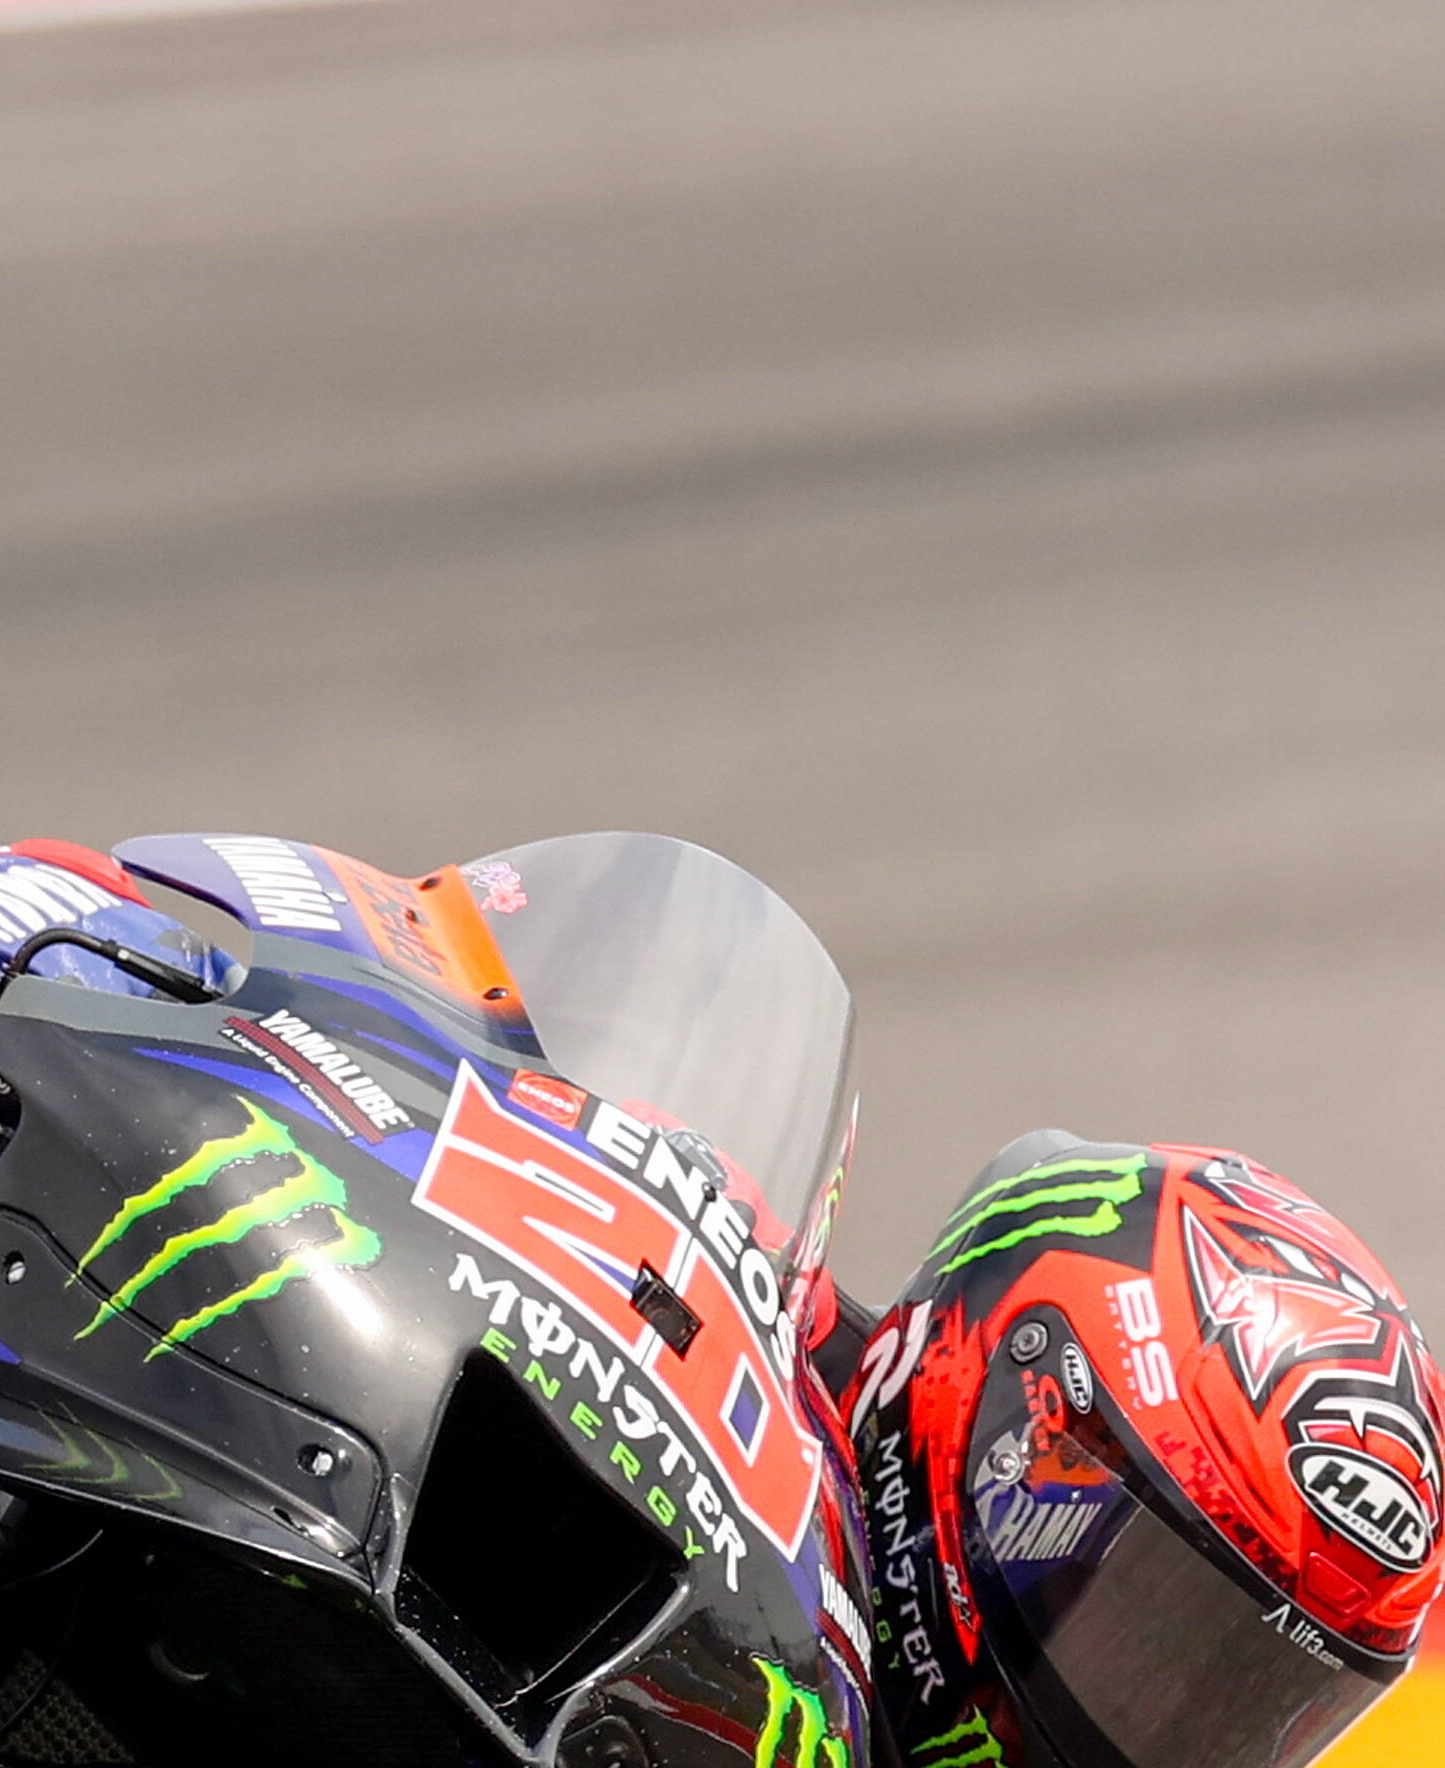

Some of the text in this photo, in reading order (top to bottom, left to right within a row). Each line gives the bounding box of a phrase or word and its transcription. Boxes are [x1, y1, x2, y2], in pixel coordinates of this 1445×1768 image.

[203, 838, 342, 932] YAMAHA
[233, 1035, 269, 1058] Liquid
[265, 1056, 301, 1084] Engine
[298, 1083, 356, 1138] Component
[259, 1009, 410, 1130] YAMALUBE
[586, 1100, 798, 1383] ENEOS
[1064, 1352, 1090, 1407] HJC
[1104, 1285, 1143, 1411] BATTERY
[1115, 1278, 1179, 1406] BS
[480, 1327, 706, 1560] ENERGY
[1308, 1460, 1425, 1556] HJC
[1340, 1510, 1393, 1551] HELMETS
[1289, 1619, 1345, 1672] lif3.com
